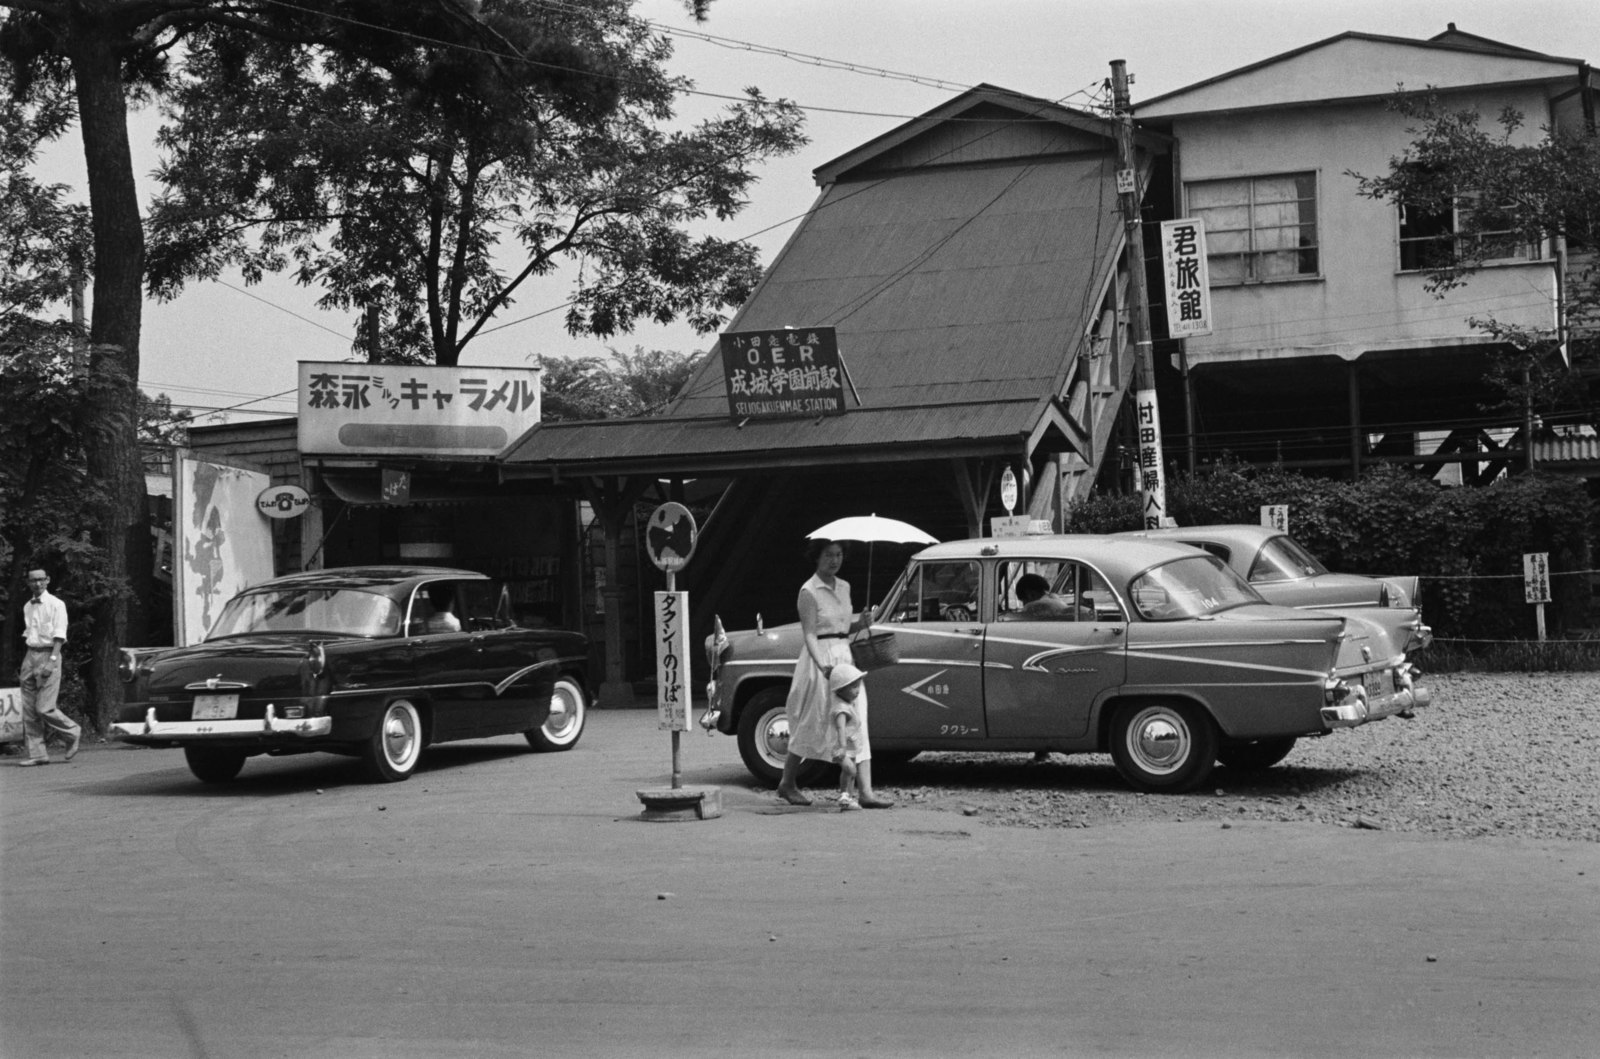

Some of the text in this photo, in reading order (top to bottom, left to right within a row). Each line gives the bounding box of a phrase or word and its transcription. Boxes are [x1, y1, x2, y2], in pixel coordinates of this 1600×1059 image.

[1173, 225, 1202, 321] 君旅館
[730, 365, 841, 396] 成城学園前駅
[805, 397, 838, 412] STATION
[1138, 401, 1161, 530] 村田産婦人科
[1200, 596, 1220, 610] 104
[662, 595, 682, 703] タクシーのりば
[941, 724, 979, 735] タクシー
